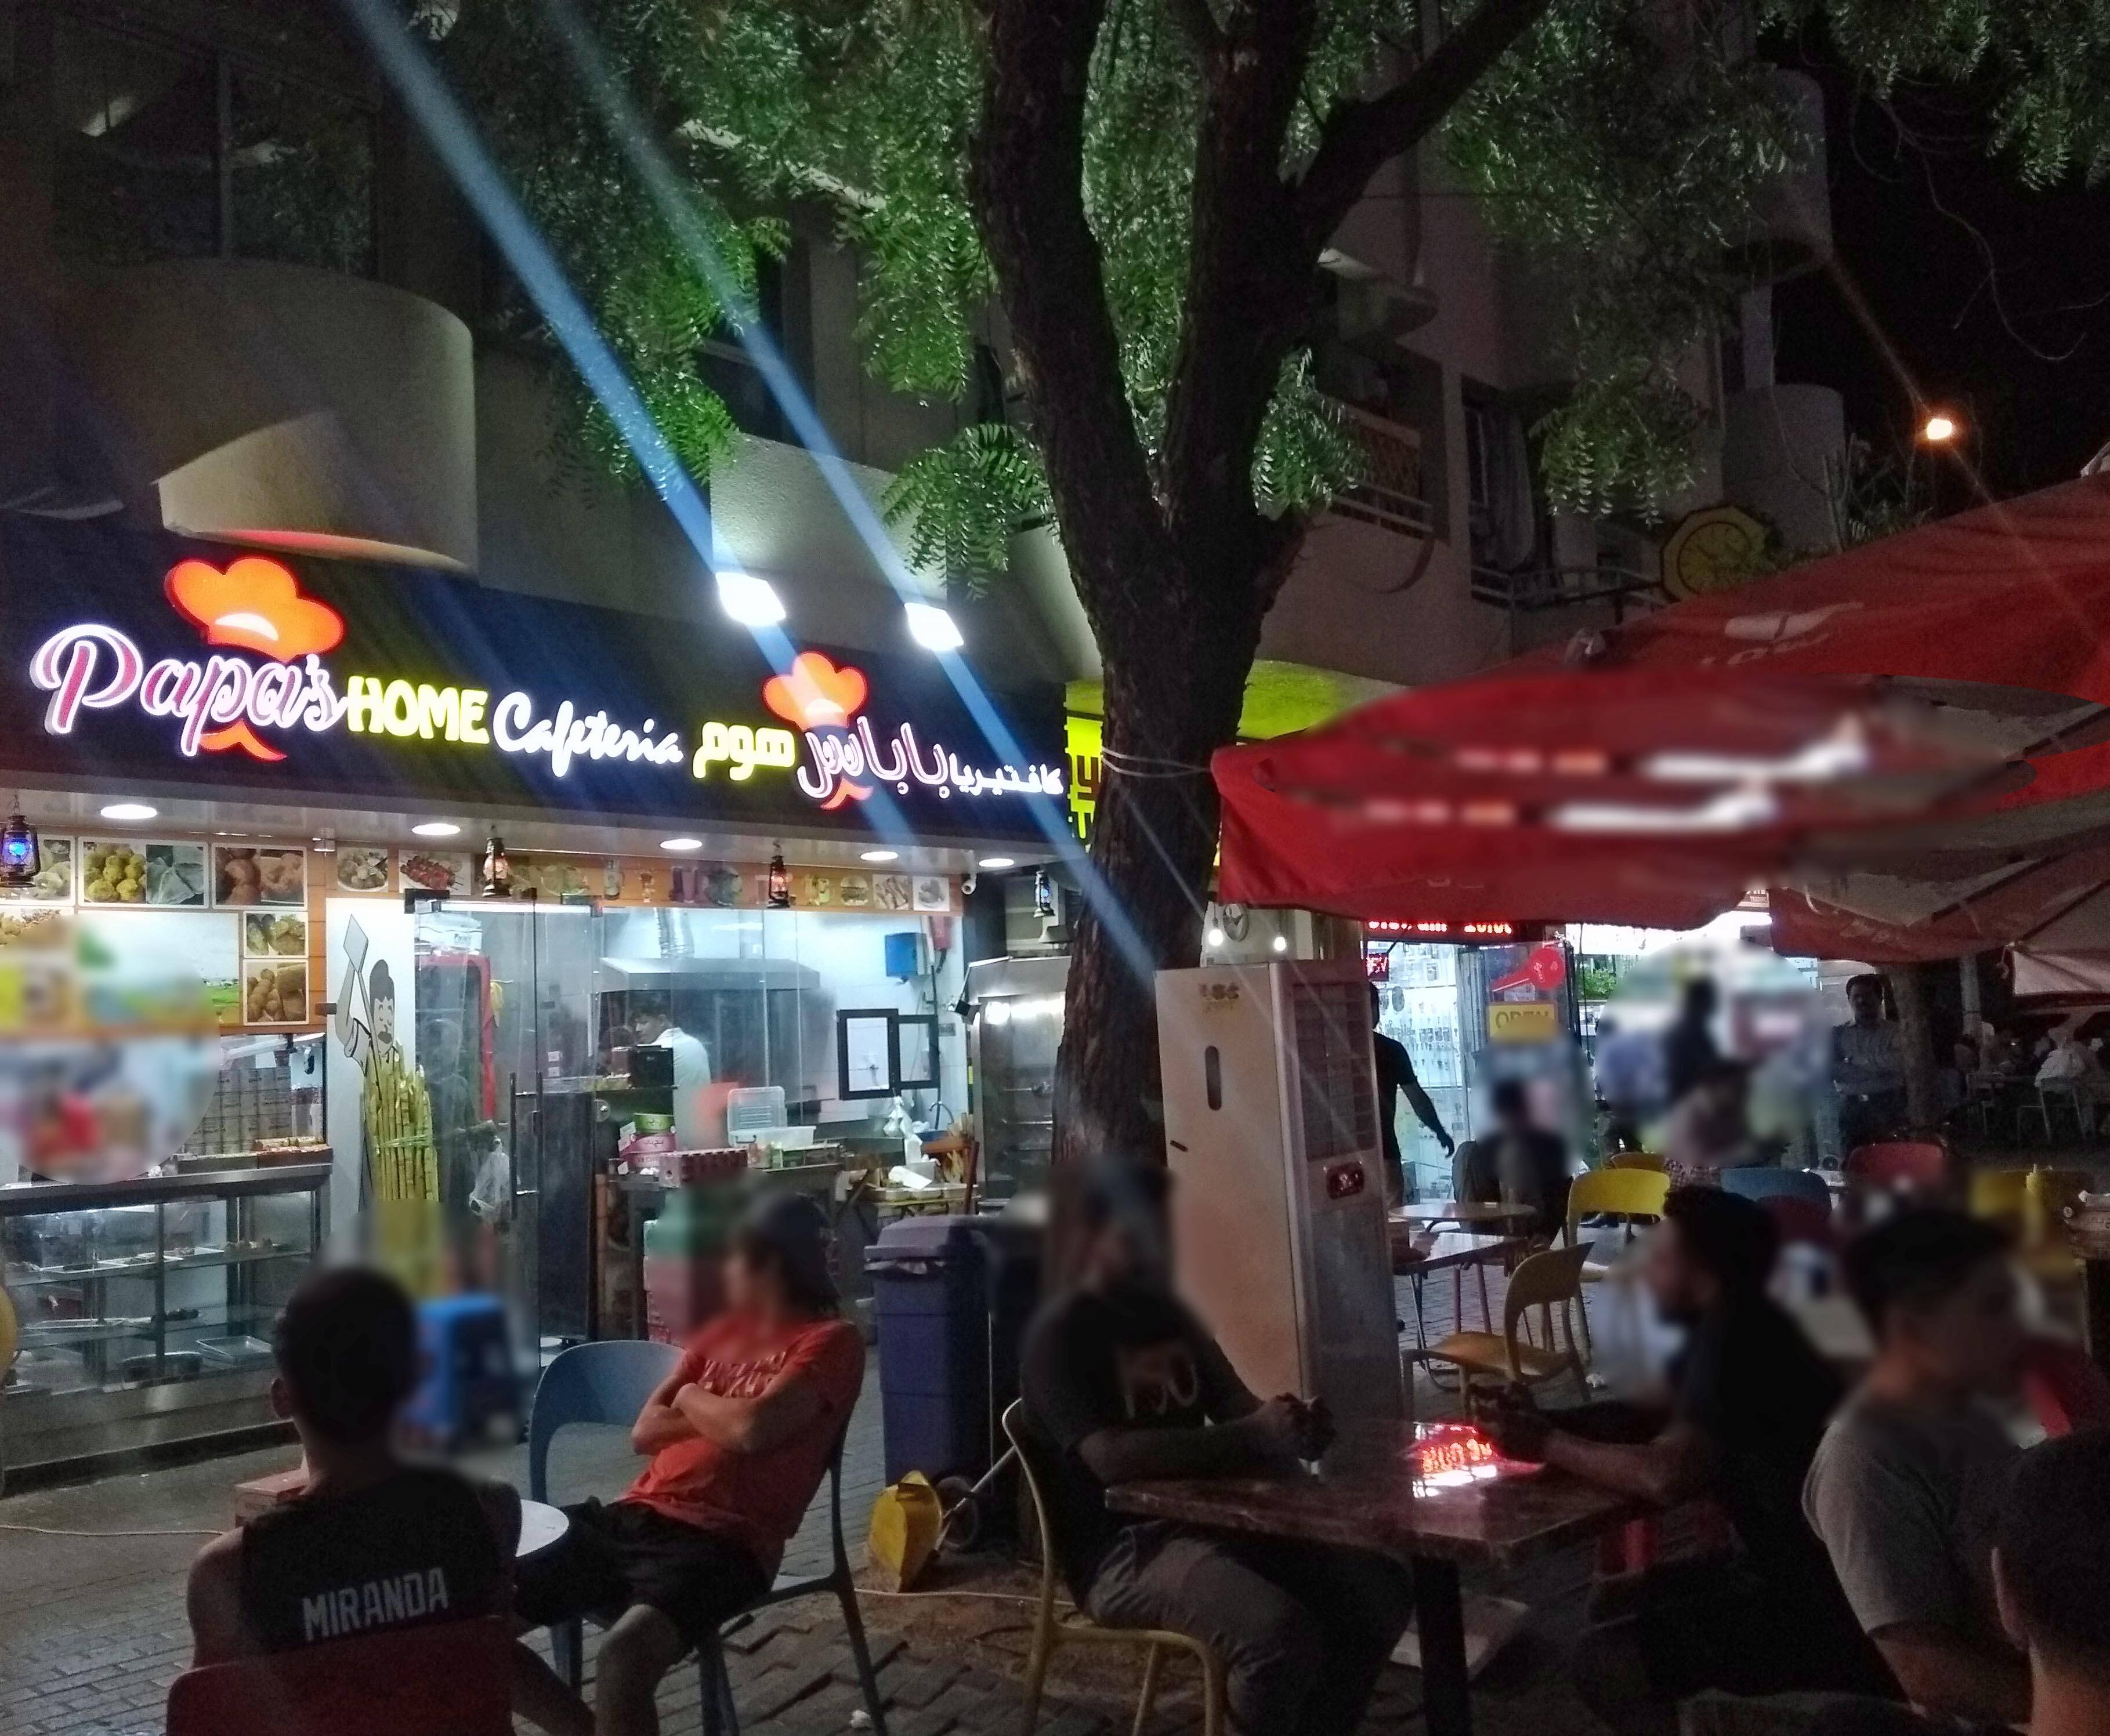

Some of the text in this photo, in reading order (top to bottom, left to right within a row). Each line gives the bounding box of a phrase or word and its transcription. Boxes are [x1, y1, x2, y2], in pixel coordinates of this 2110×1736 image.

[31, 624, 684, 778] Papa's HOME Cafeteria
[692, 721, 795, 781] هوم
[1496, 1011, 1549, 1029] OP
[302, 1567, 449, 1641] MIRANDA
